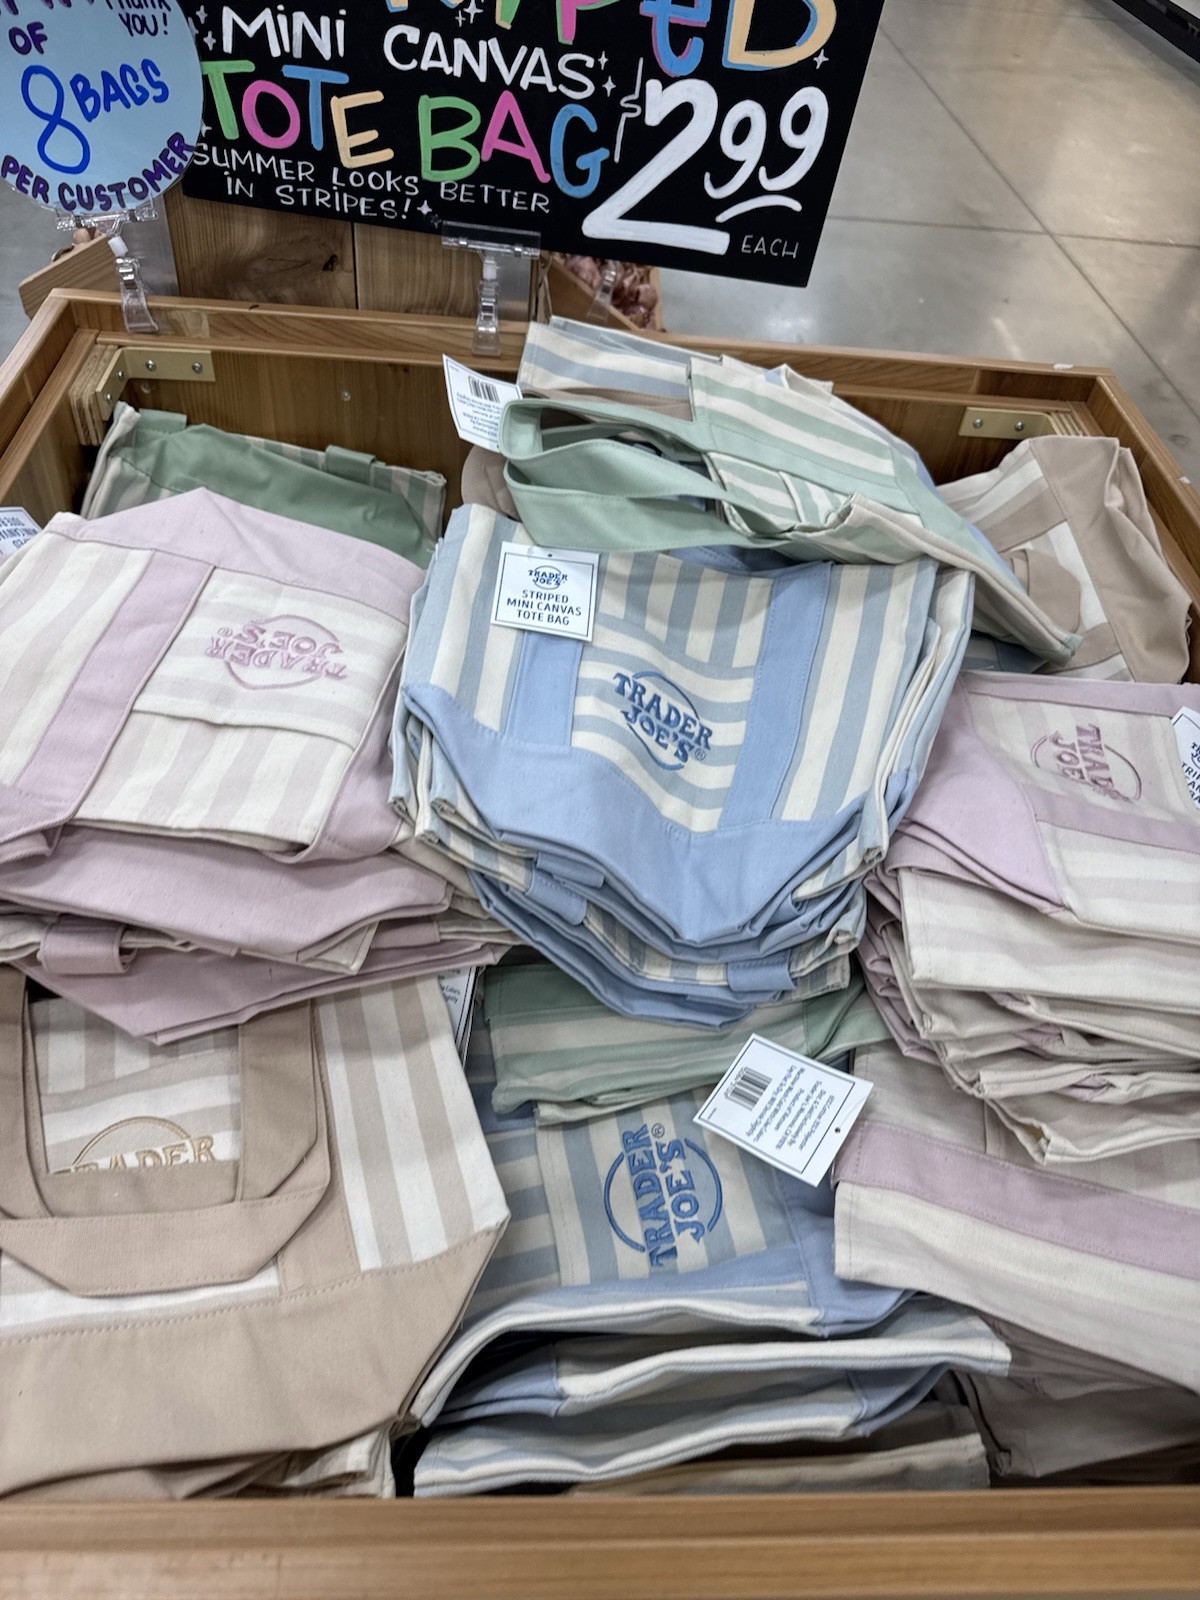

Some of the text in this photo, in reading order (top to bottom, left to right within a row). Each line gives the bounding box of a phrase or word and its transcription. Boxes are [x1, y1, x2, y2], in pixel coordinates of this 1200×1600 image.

[8, 21, 48, 55] OF
[118, 12, 168, 37] YOU!
[383, 25, 595, 99] CANVAS
[21, 58, 169, 174] 8 BAGS
[201, 60, 609, 198] TOTE BAG
[1, 131, 196, 211] PER CUSTOMER
[193, 143, 550, 214] SUMMER LOOKS BETTER
[741, 235, 799, 260] EACH
[522, 590, 569, 603] STRIPED
[528, 570, 568, 581] TRADER
[532, 577, 561, 587] JOE'S
[506, 598, 582, 616] MINI CANVAS
[517, 609, 570, 626] TOTE BAG
[205, 636, 347, 680] TRADER
[613, 672, 713, 750] TRADER
[620, 705, 695, 763] JOE'S
[622, 1124, 678, 1267] TRADER
[655, 1139, 705, 1244] JOE'S
